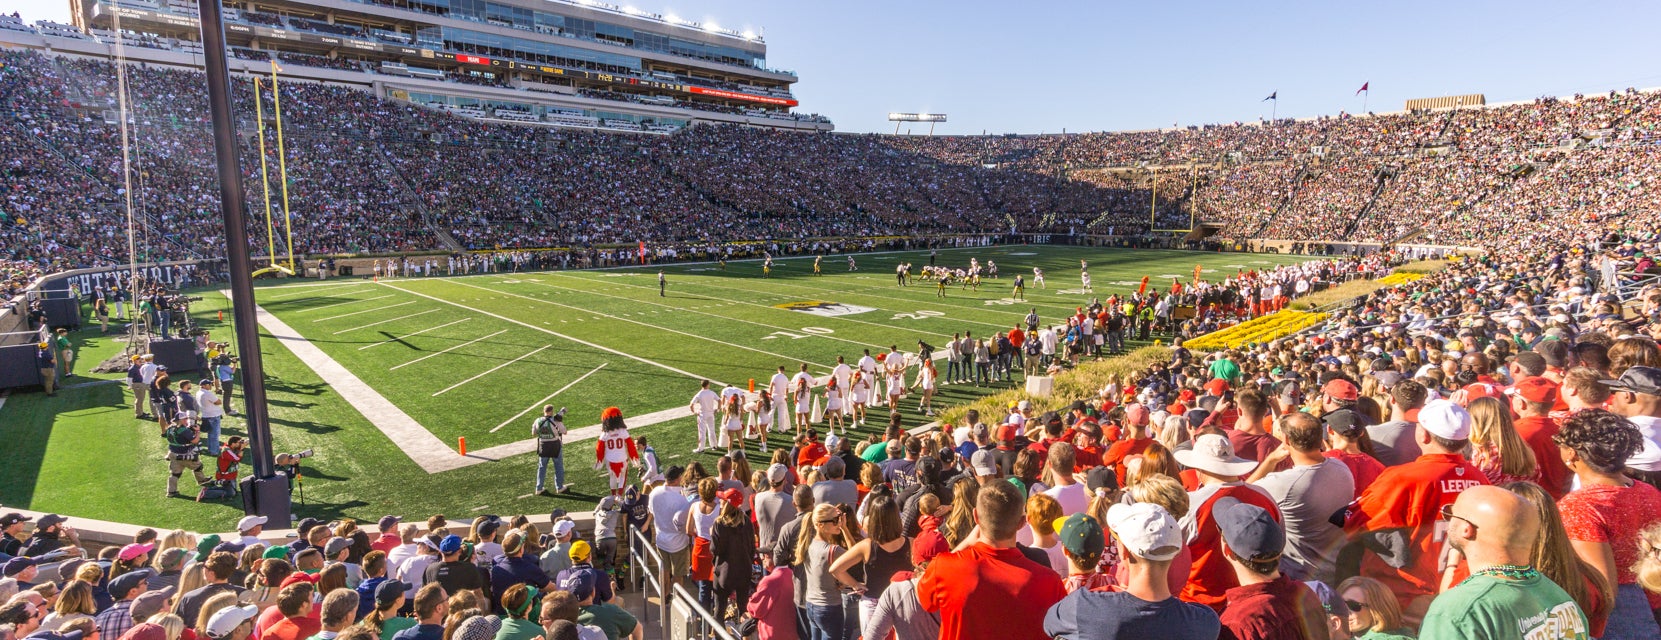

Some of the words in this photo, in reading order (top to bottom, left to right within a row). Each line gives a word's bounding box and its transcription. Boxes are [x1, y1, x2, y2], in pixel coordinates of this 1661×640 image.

[892, 310, 946, 320] 20
[768, 326, 835, 340] 10
[608, 438, 623, 450] 00
